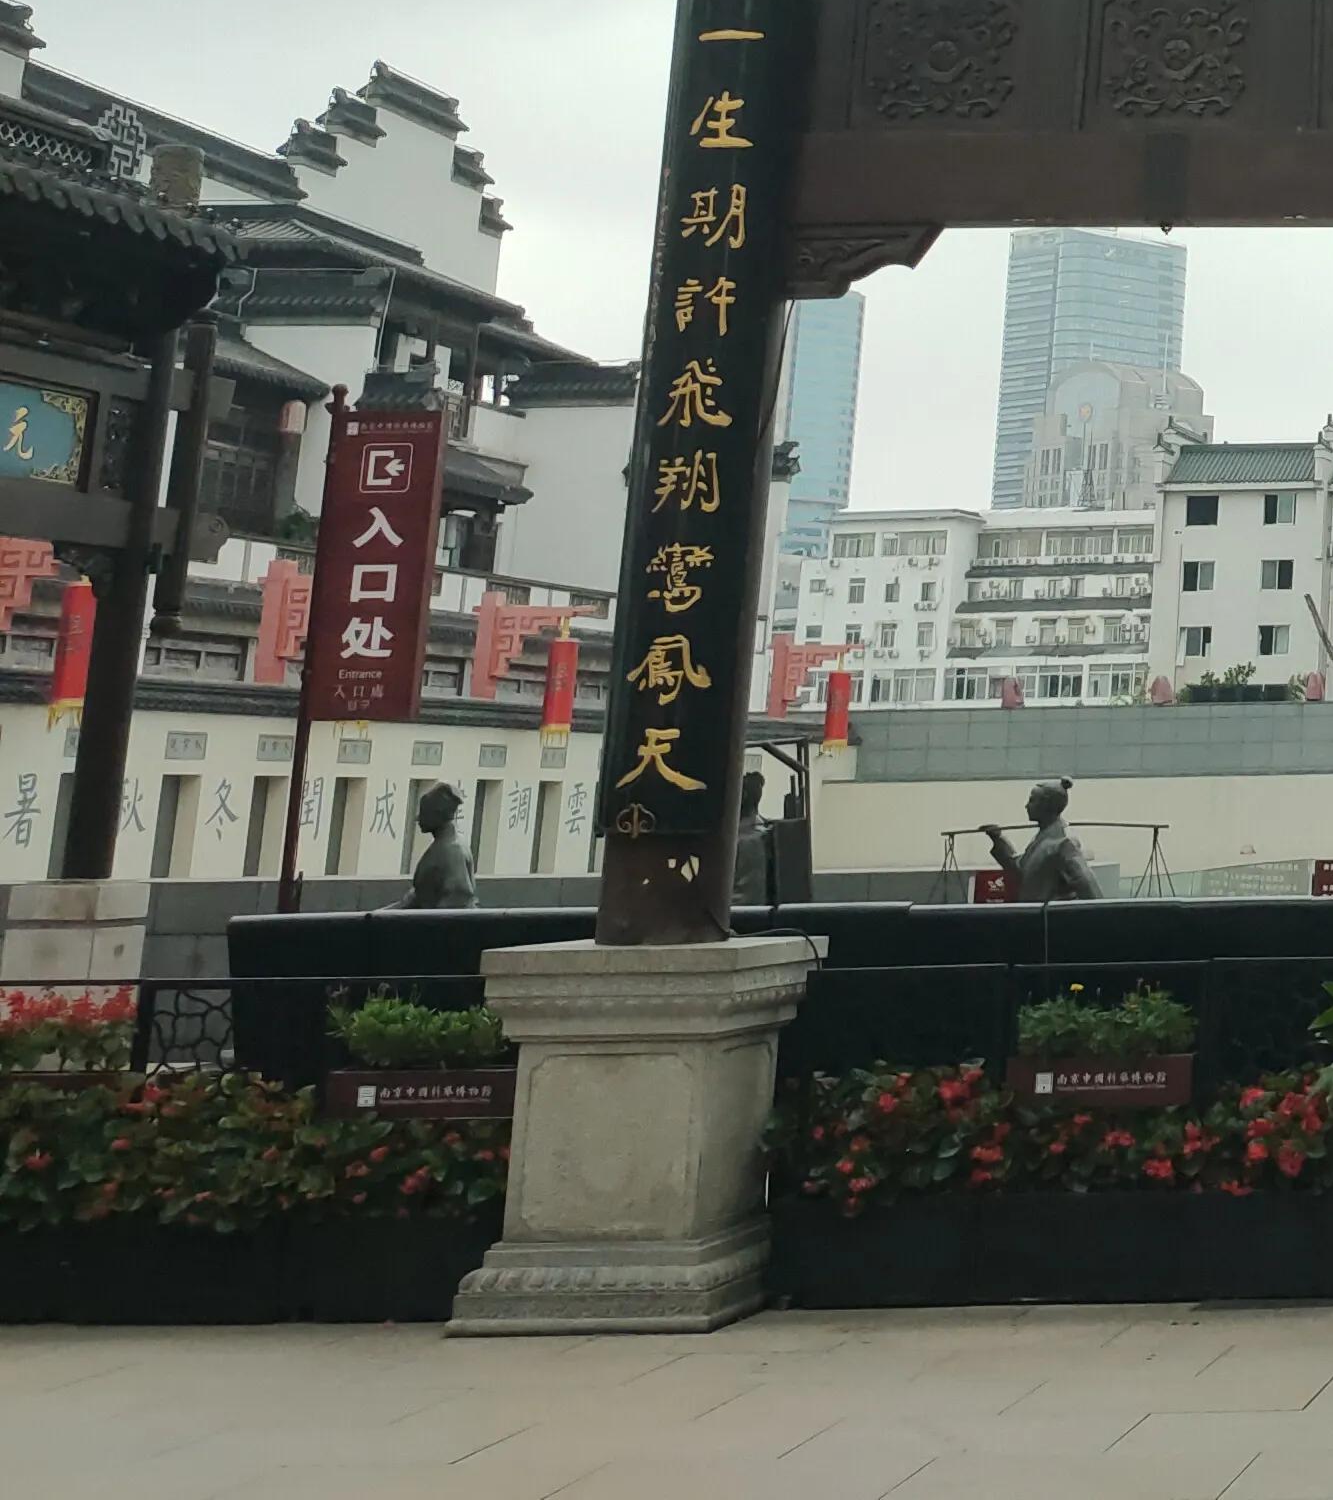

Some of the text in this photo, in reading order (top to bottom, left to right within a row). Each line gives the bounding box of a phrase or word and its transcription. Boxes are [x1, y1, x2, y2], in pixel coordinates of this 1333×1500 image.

[340, 506, 404, 660] 入口处
[338, 669, 383, 679] Entrance
